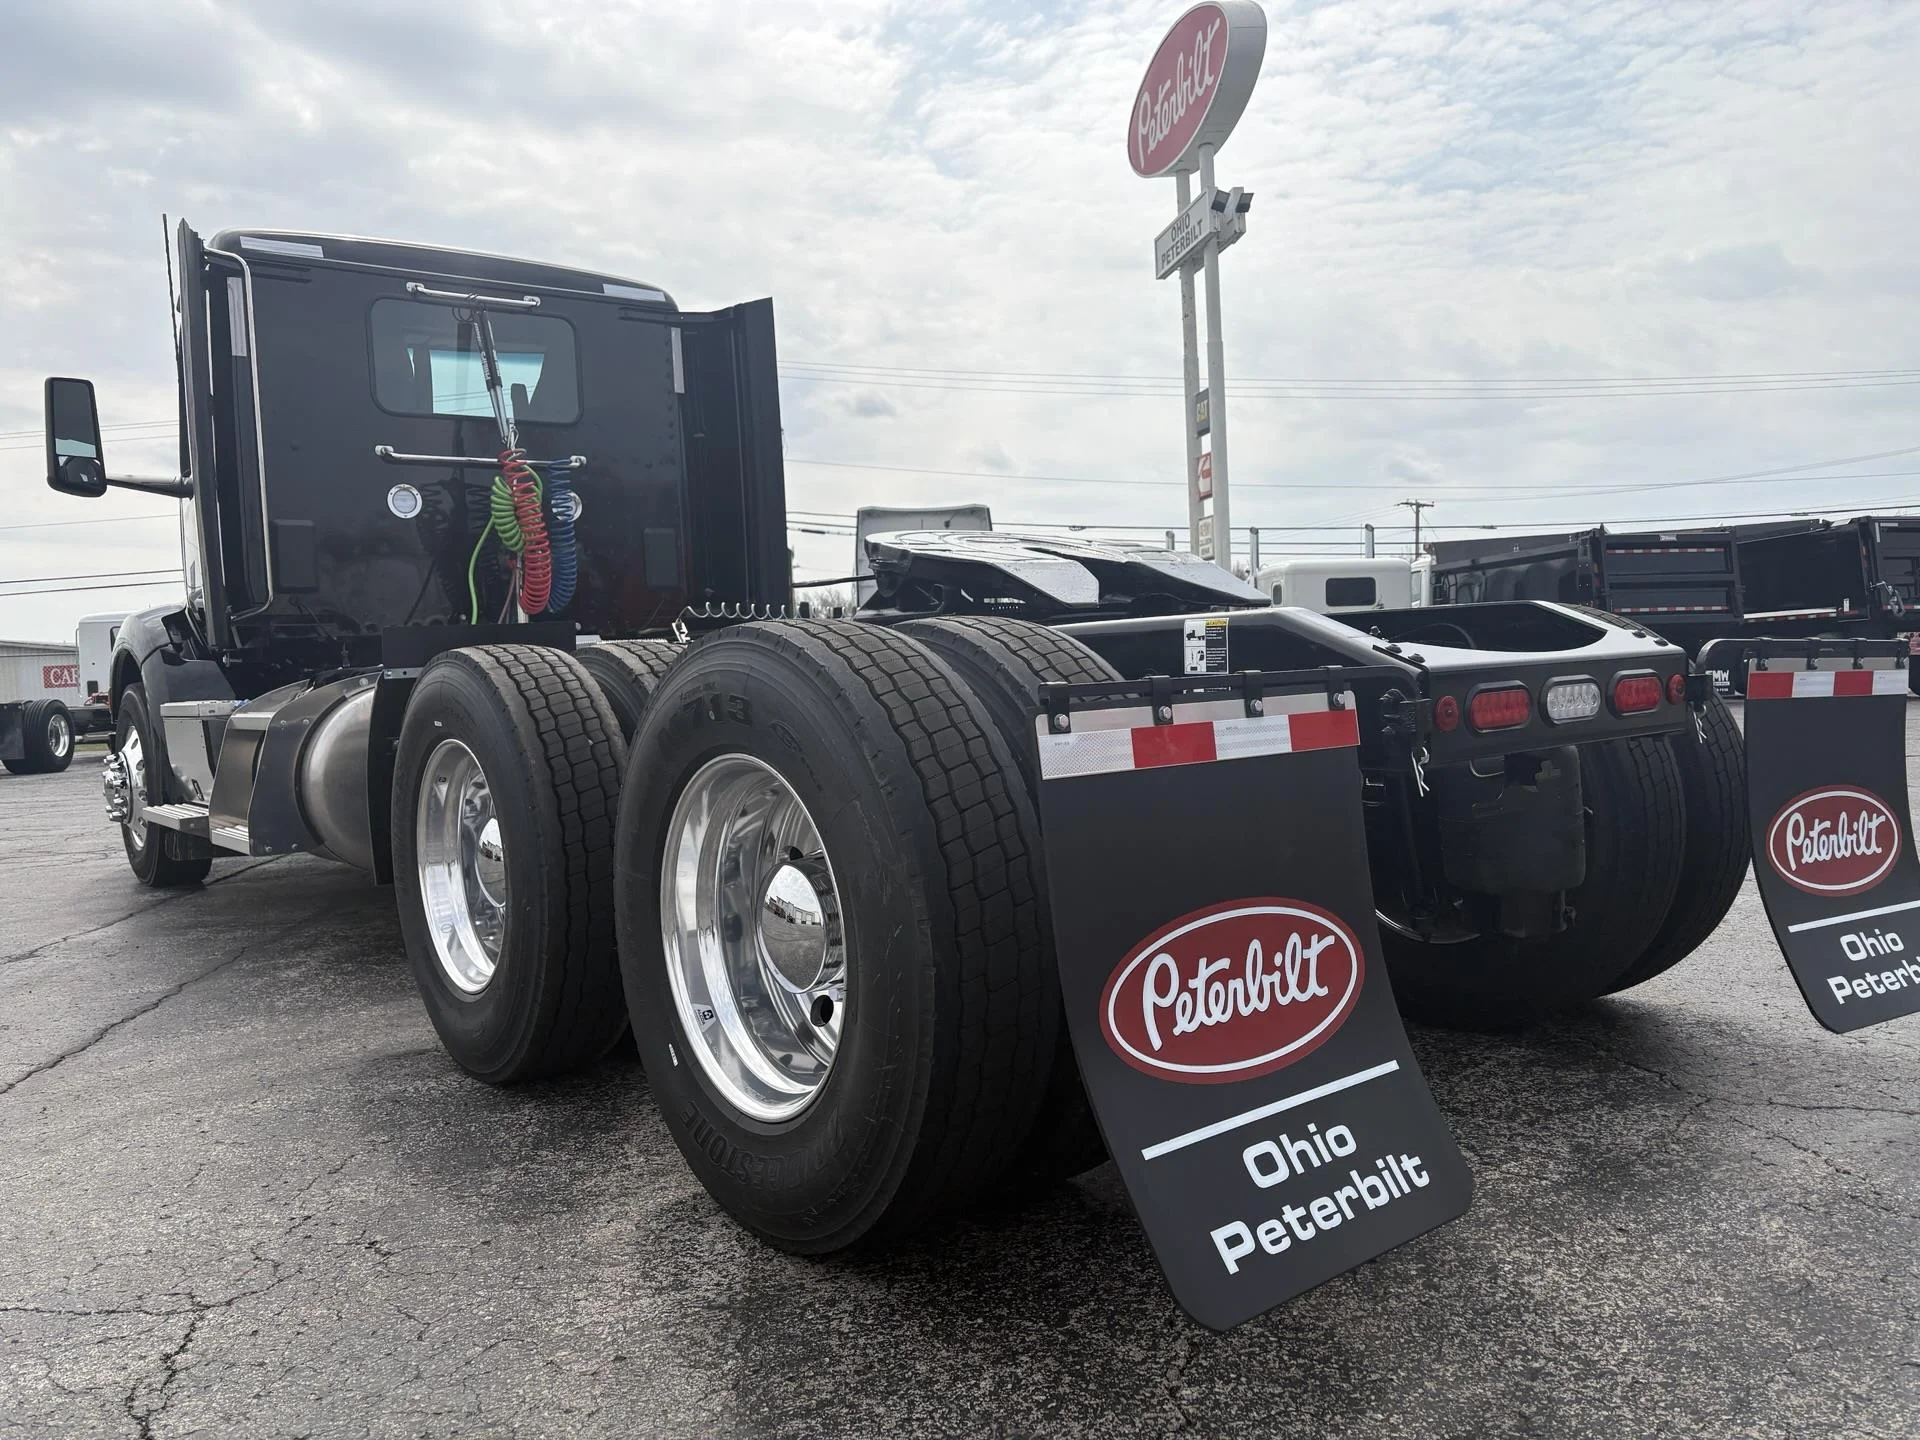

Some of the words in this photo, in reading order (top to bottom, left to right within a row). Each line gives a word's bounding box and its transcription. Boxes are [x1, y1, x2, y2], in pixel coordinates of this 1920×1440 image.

[1137, 17, 1220, 169] Peterbilt
[1161, 218, 1203, 270] PETERBILT
[1171, 213, 1190, 243] OHIO
[1786, 810, 1886, 871] Peterbilt
[1840, 928, 1905, 961] Ohio
[1143, 932, 1335, 1051] Peterbilt
[1826, 956, 1920, 1005] Peterb
[1242, 1122, 1357, 1189] Ohio
[1209, 1153, 1430, 1275] Peterbilt
